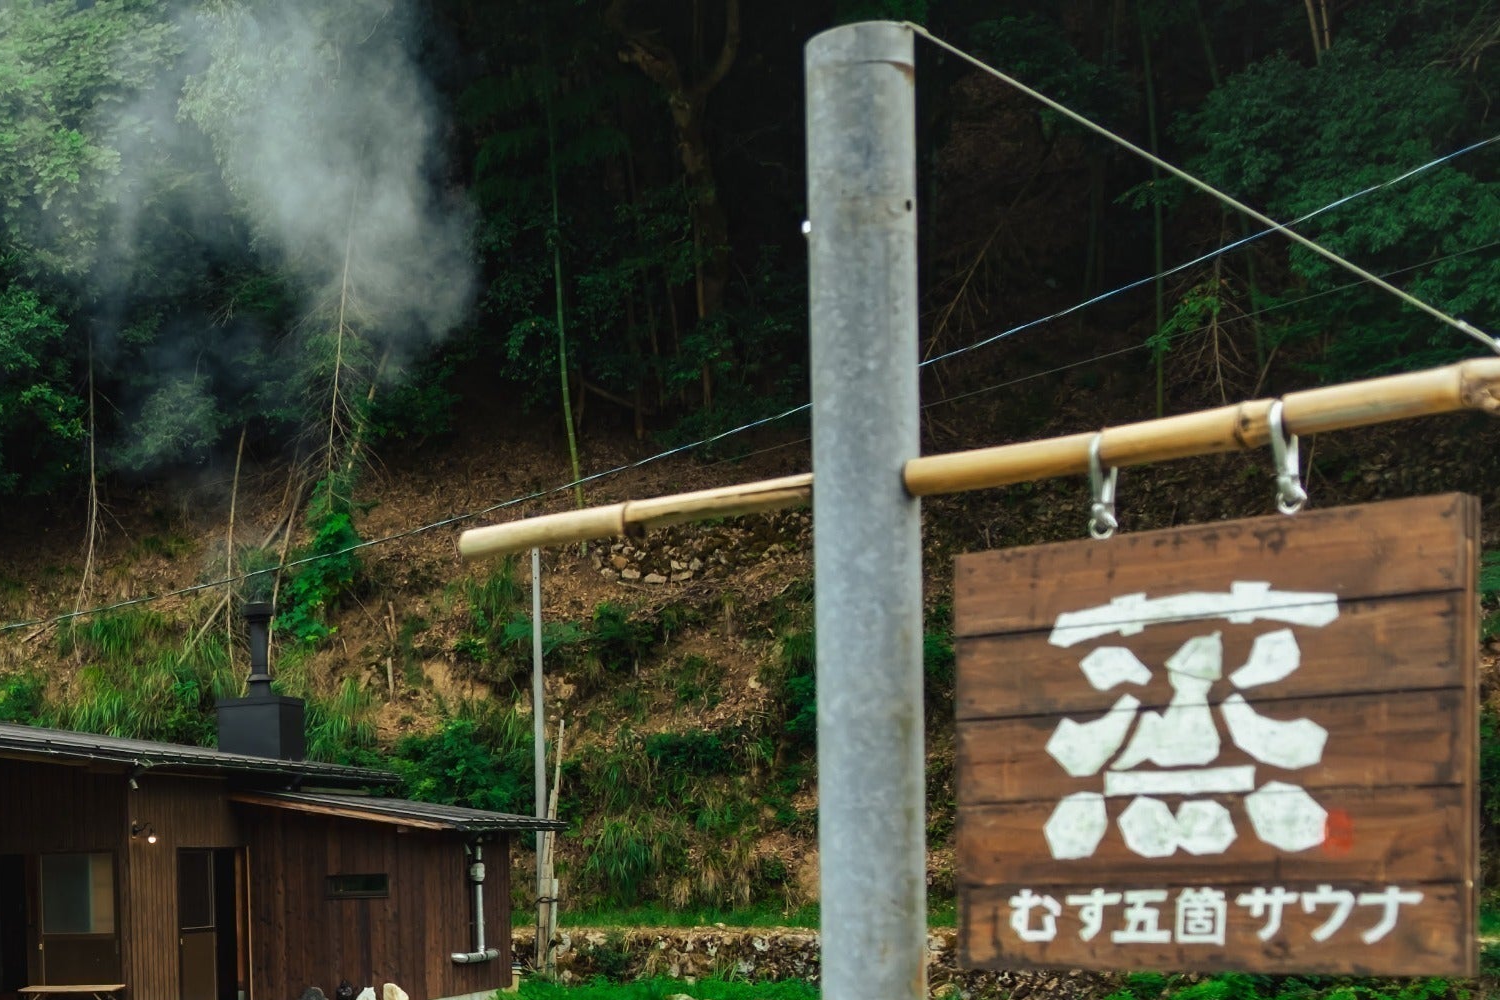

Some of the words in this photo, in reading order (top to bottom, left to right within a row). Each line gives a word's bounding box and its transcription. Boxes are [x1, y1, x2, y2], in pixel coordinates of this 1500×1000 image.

[1009, 885, 1424, 945] むす五箇サウナ
